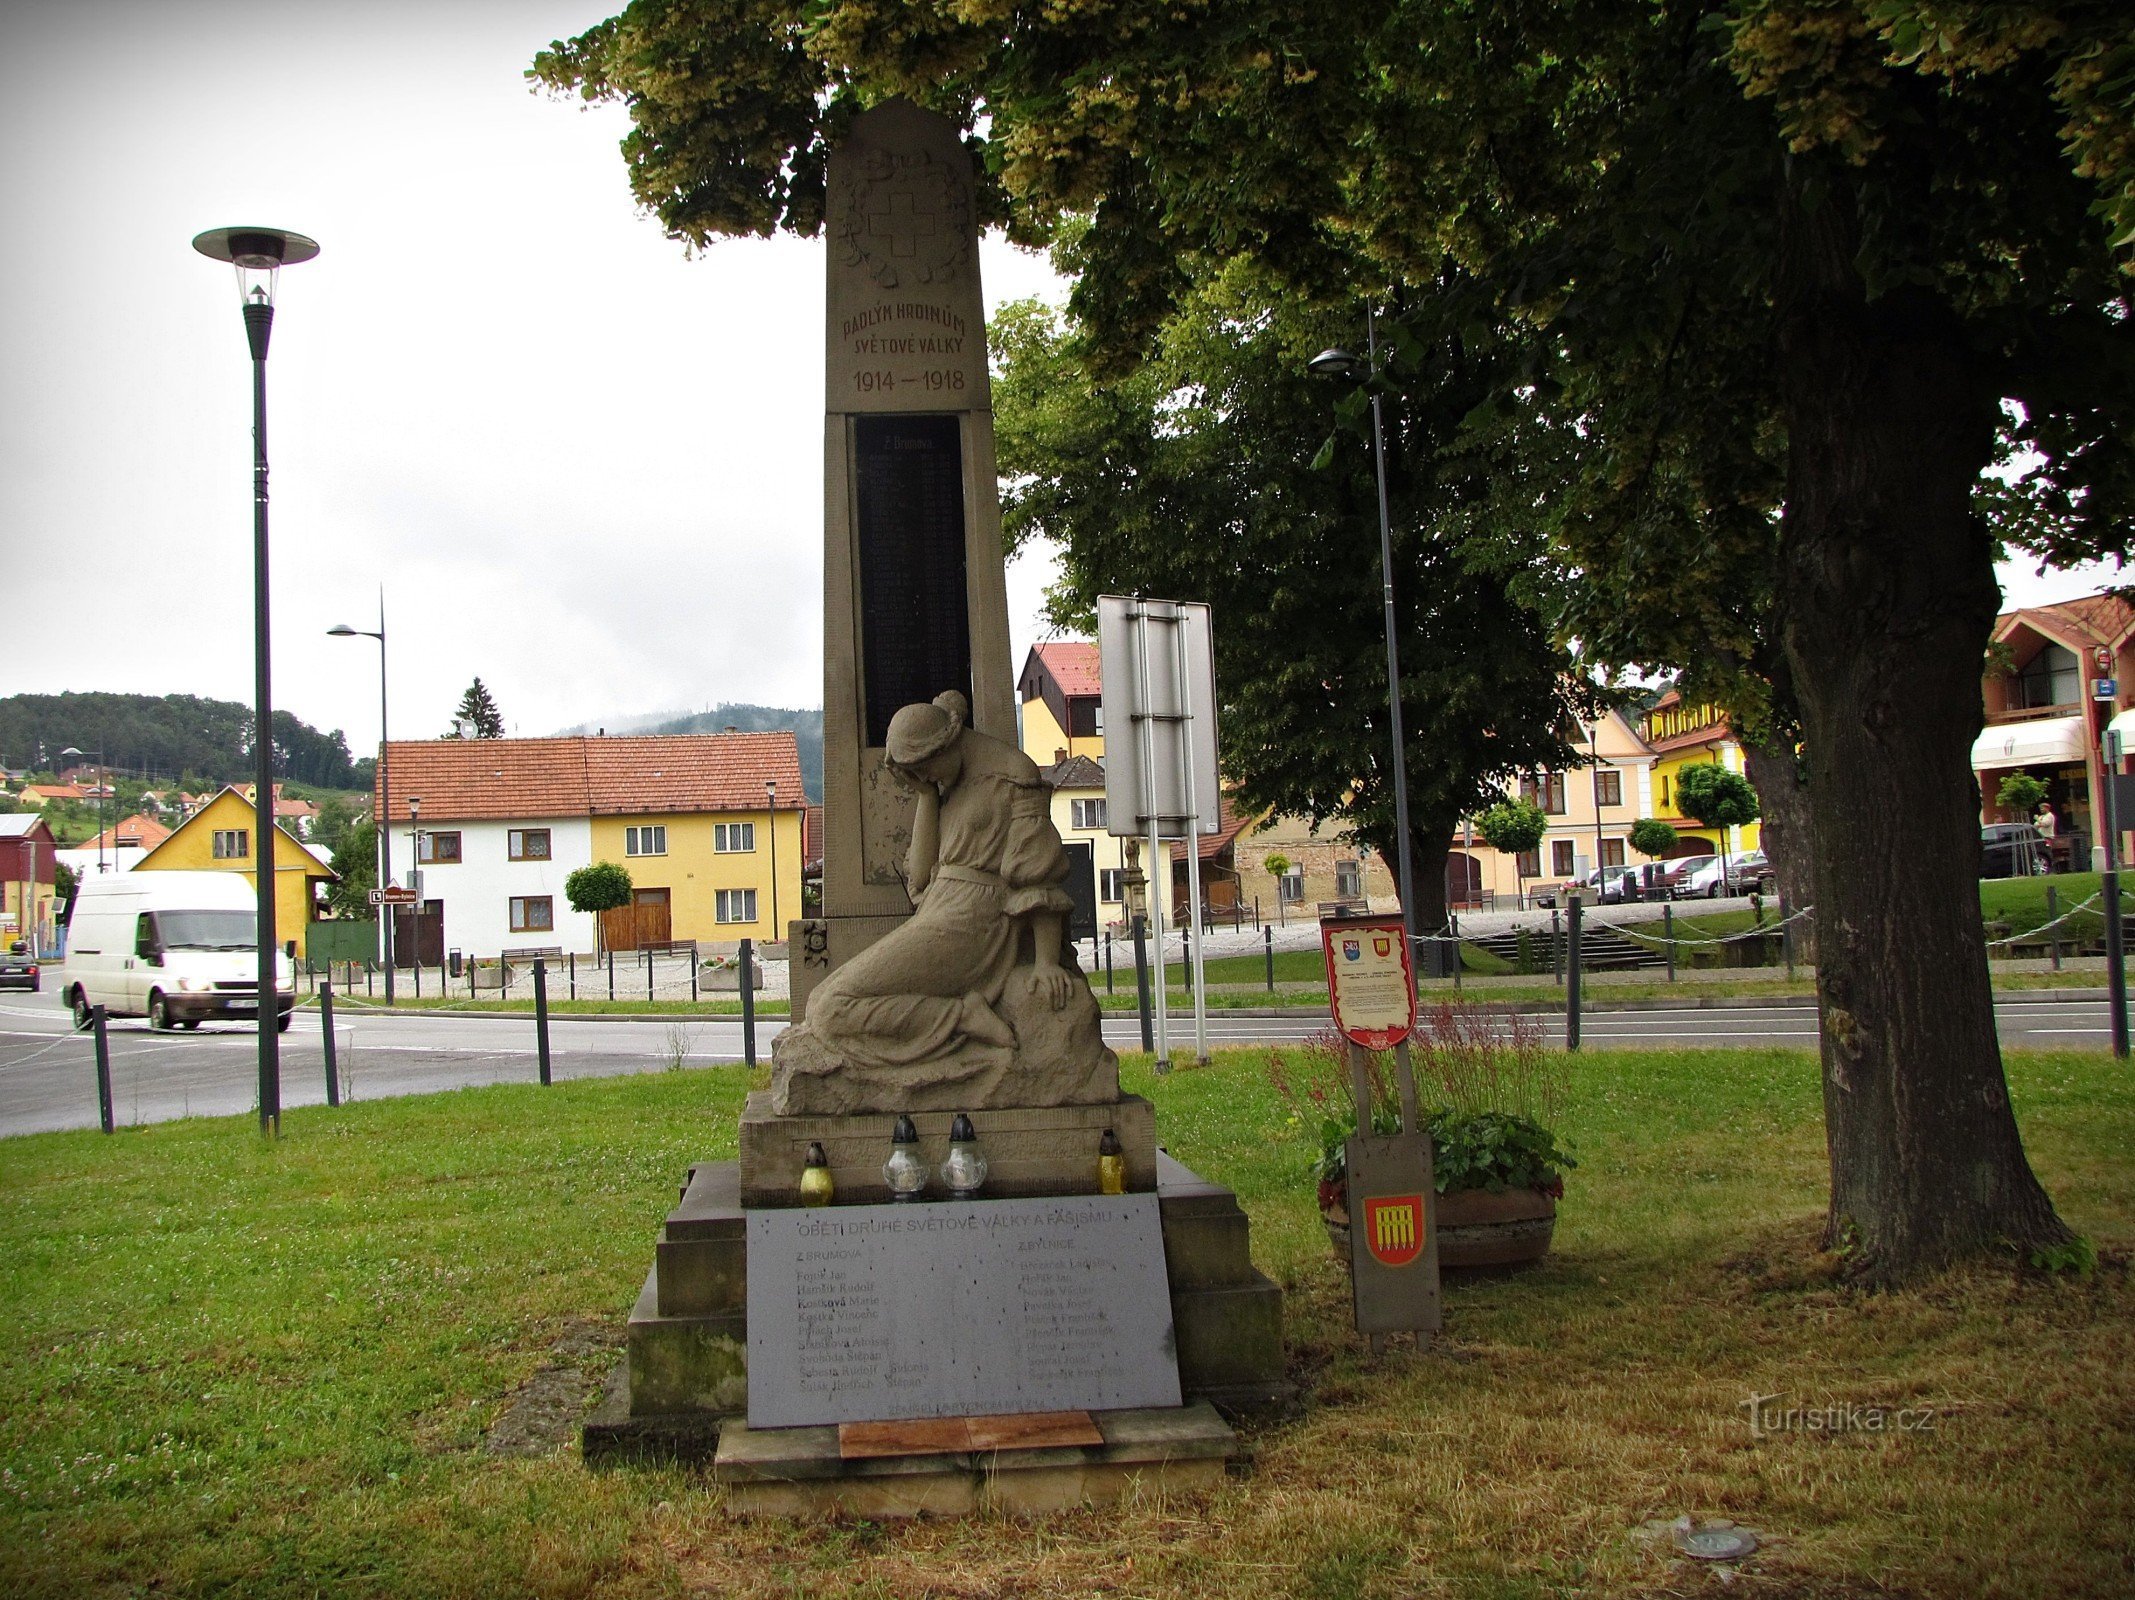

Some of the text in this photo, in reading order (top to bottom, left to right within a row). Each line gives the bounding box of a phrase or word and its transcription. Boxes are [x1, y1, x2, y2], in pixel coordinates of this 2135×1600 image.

[843, 300, 892, 341] PADLÝM
[855, 332, 963, 354] SVĚTOVÉ VÁLKY
[1034, 1214, 1043, 1226] A
[806, 1249, 862, 1261] BRUMOVA
